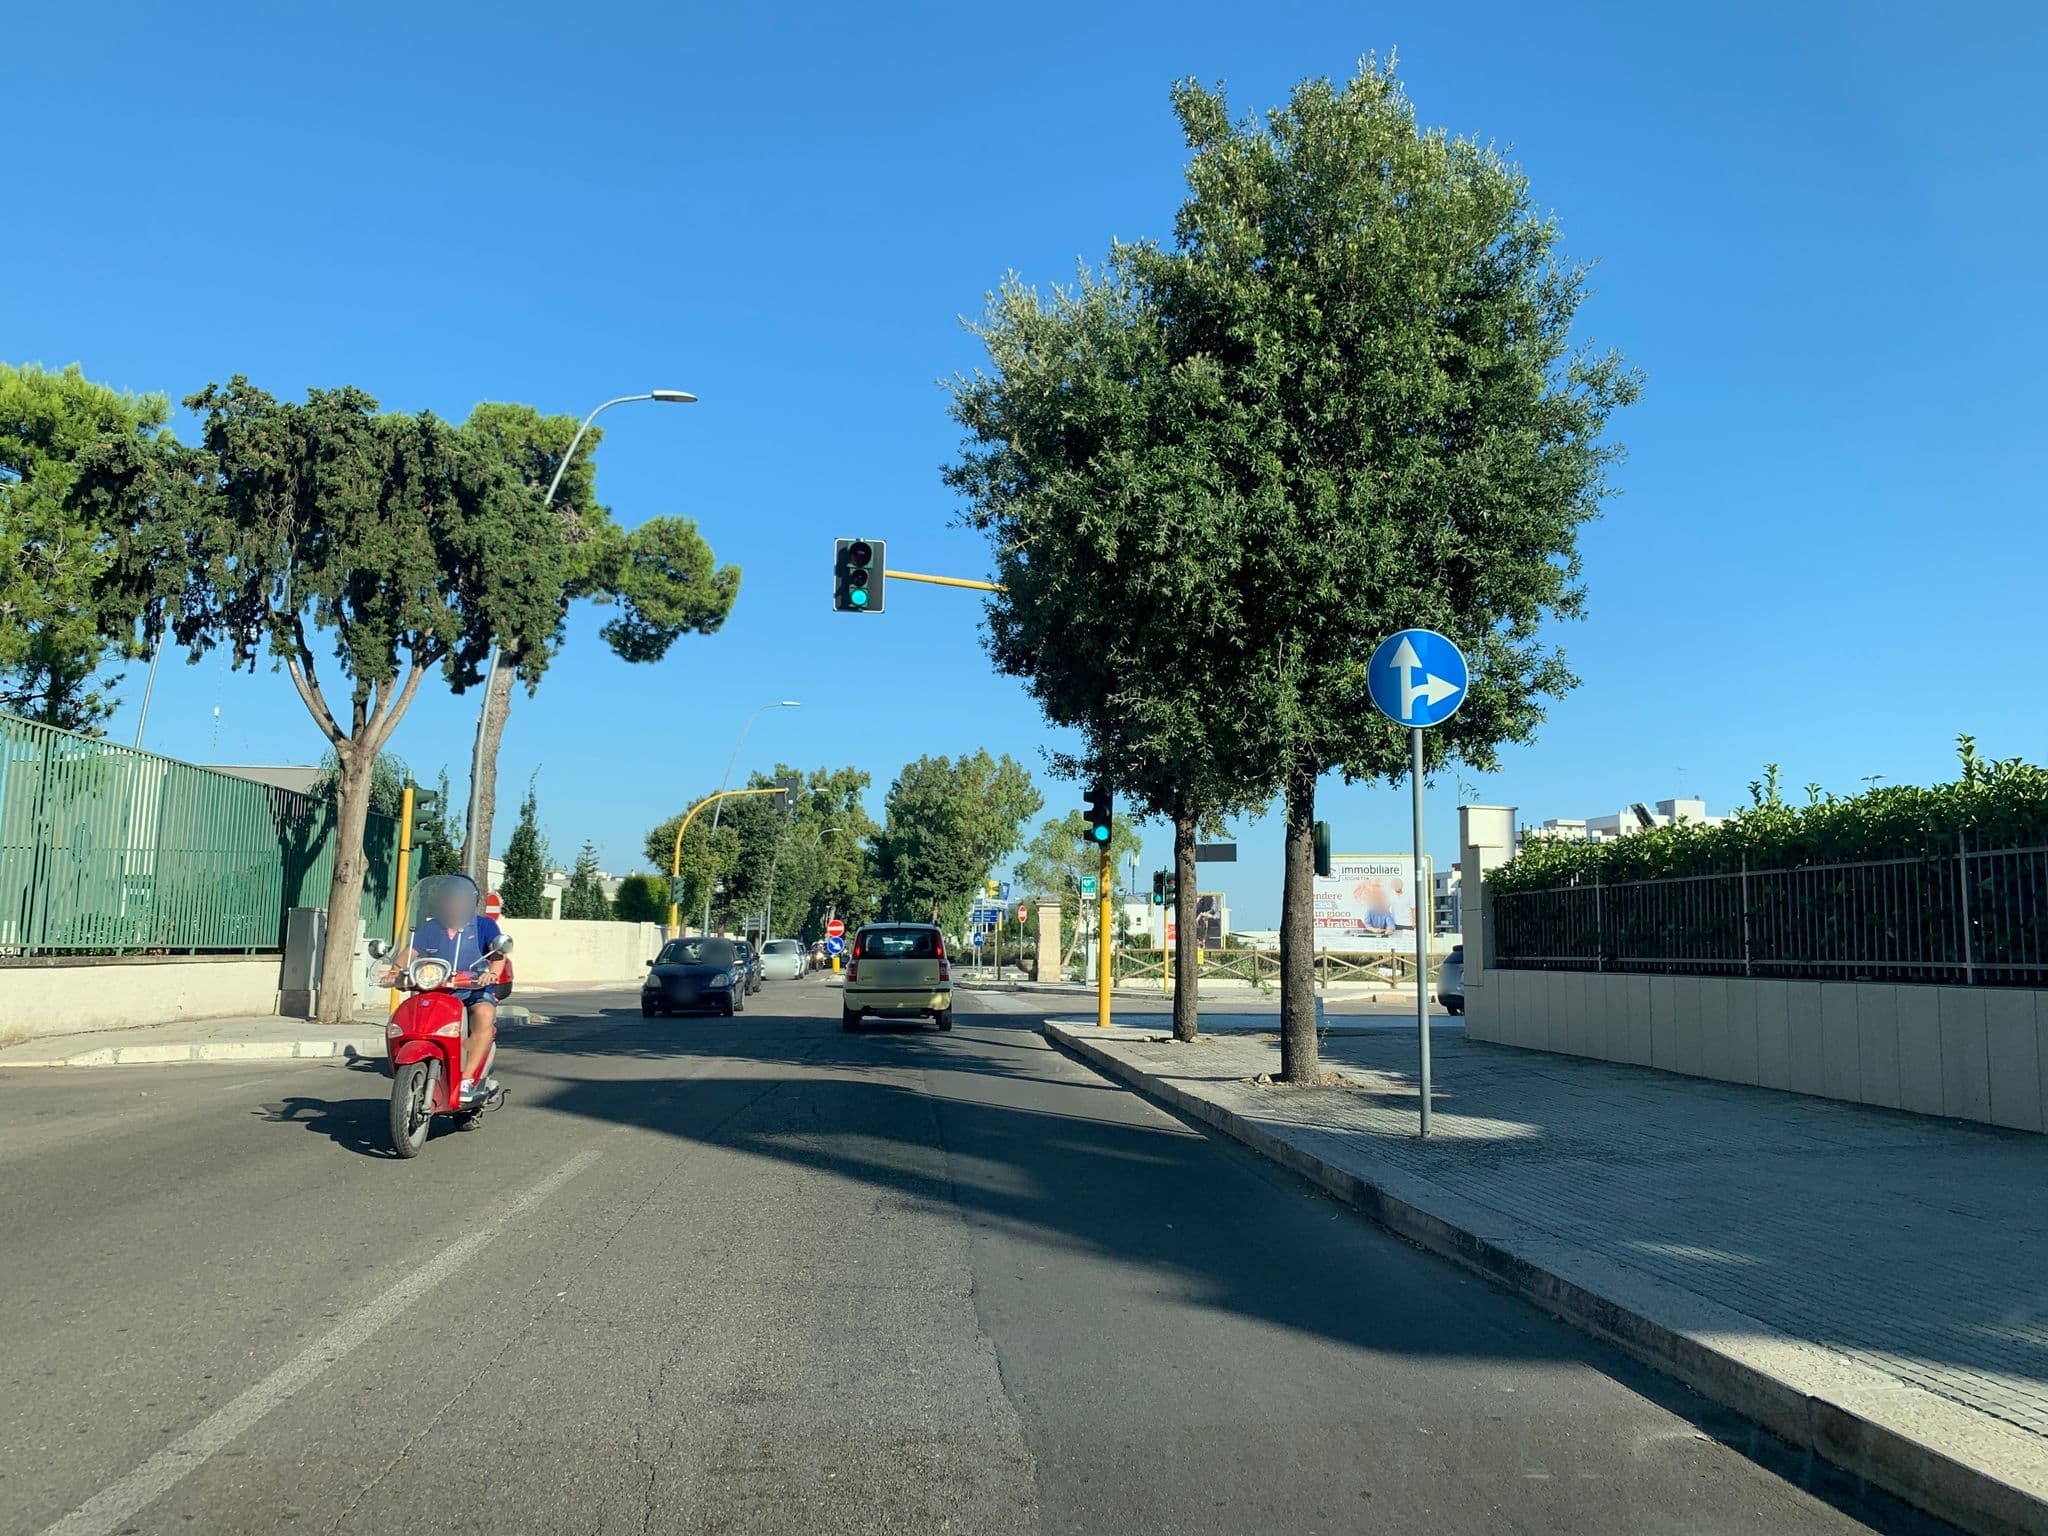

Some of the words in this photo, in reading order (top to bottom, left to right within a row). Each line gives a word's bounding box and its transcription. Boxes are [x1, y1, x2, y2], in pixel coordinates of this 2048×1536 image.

[1341, 864, 1399, 874] immobiliare
[1327, 909, 1351, 920] gioco
[1327, 919, 1358, 928] fratelli
